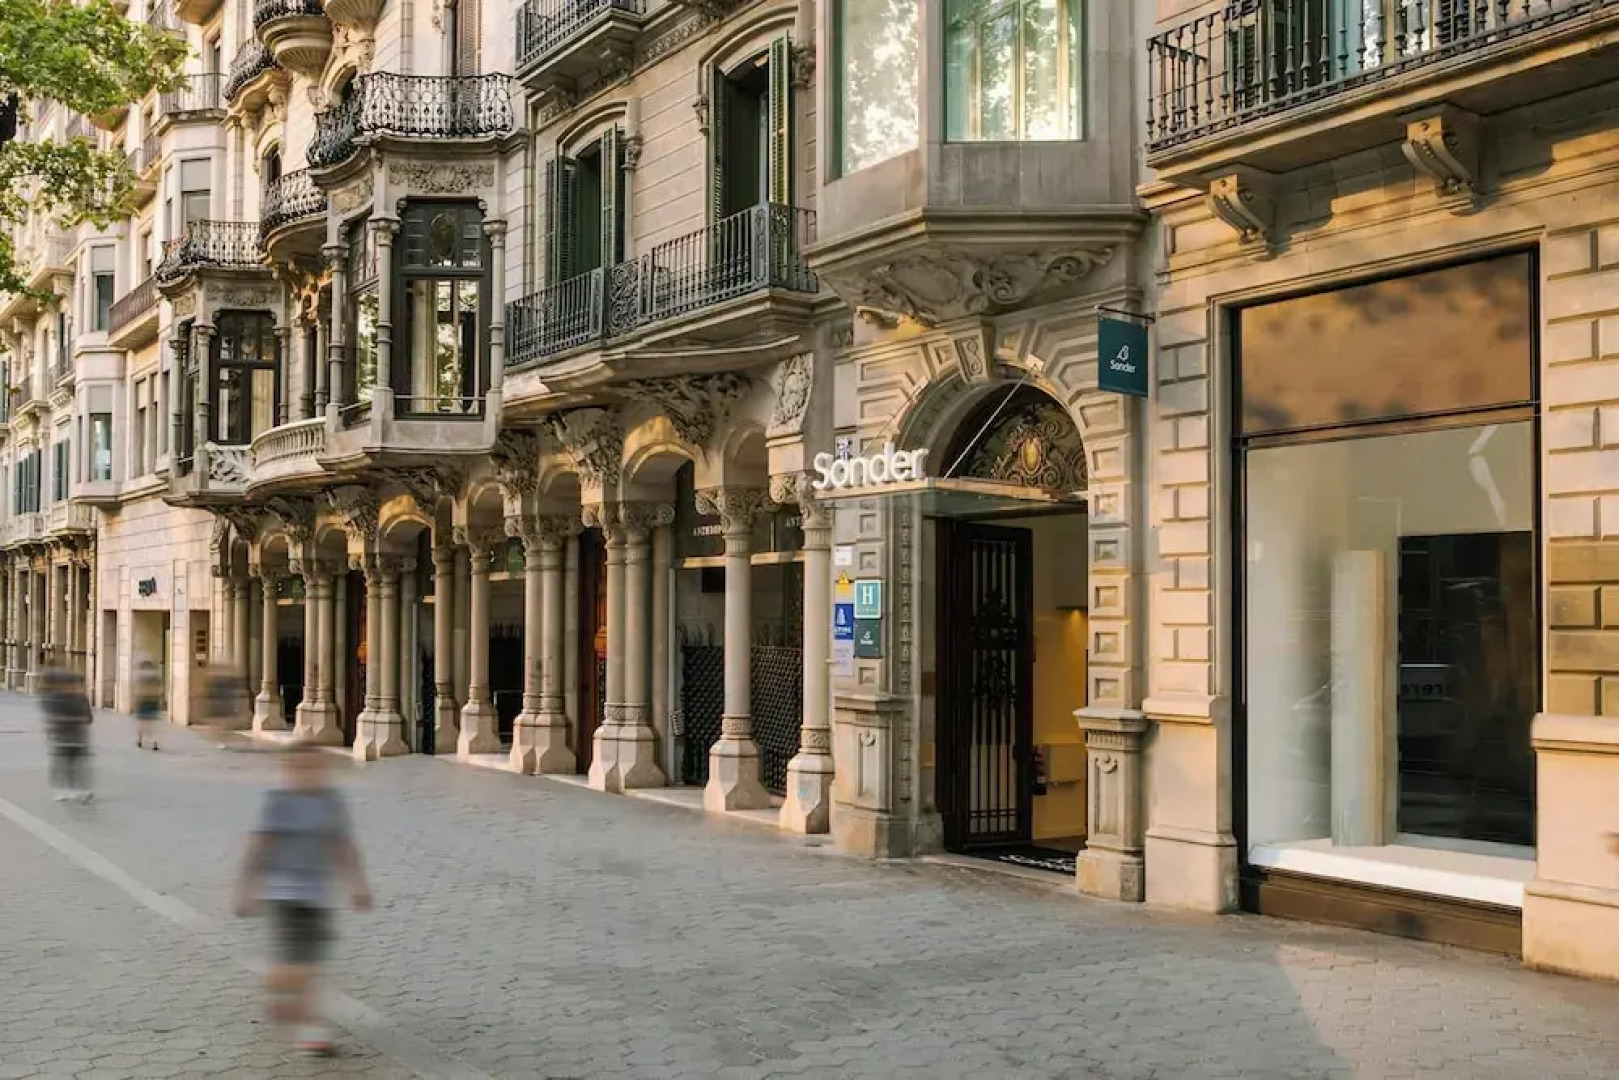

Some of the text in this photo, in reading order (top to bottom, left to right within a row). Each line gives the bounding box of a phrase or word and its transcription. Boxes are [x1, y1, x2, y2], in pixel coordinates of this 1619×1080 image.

[1110, 359, 1136, 373] Sonder
[812, 441, 929, 489] Sonder
[862, 585, 874, 605] H
